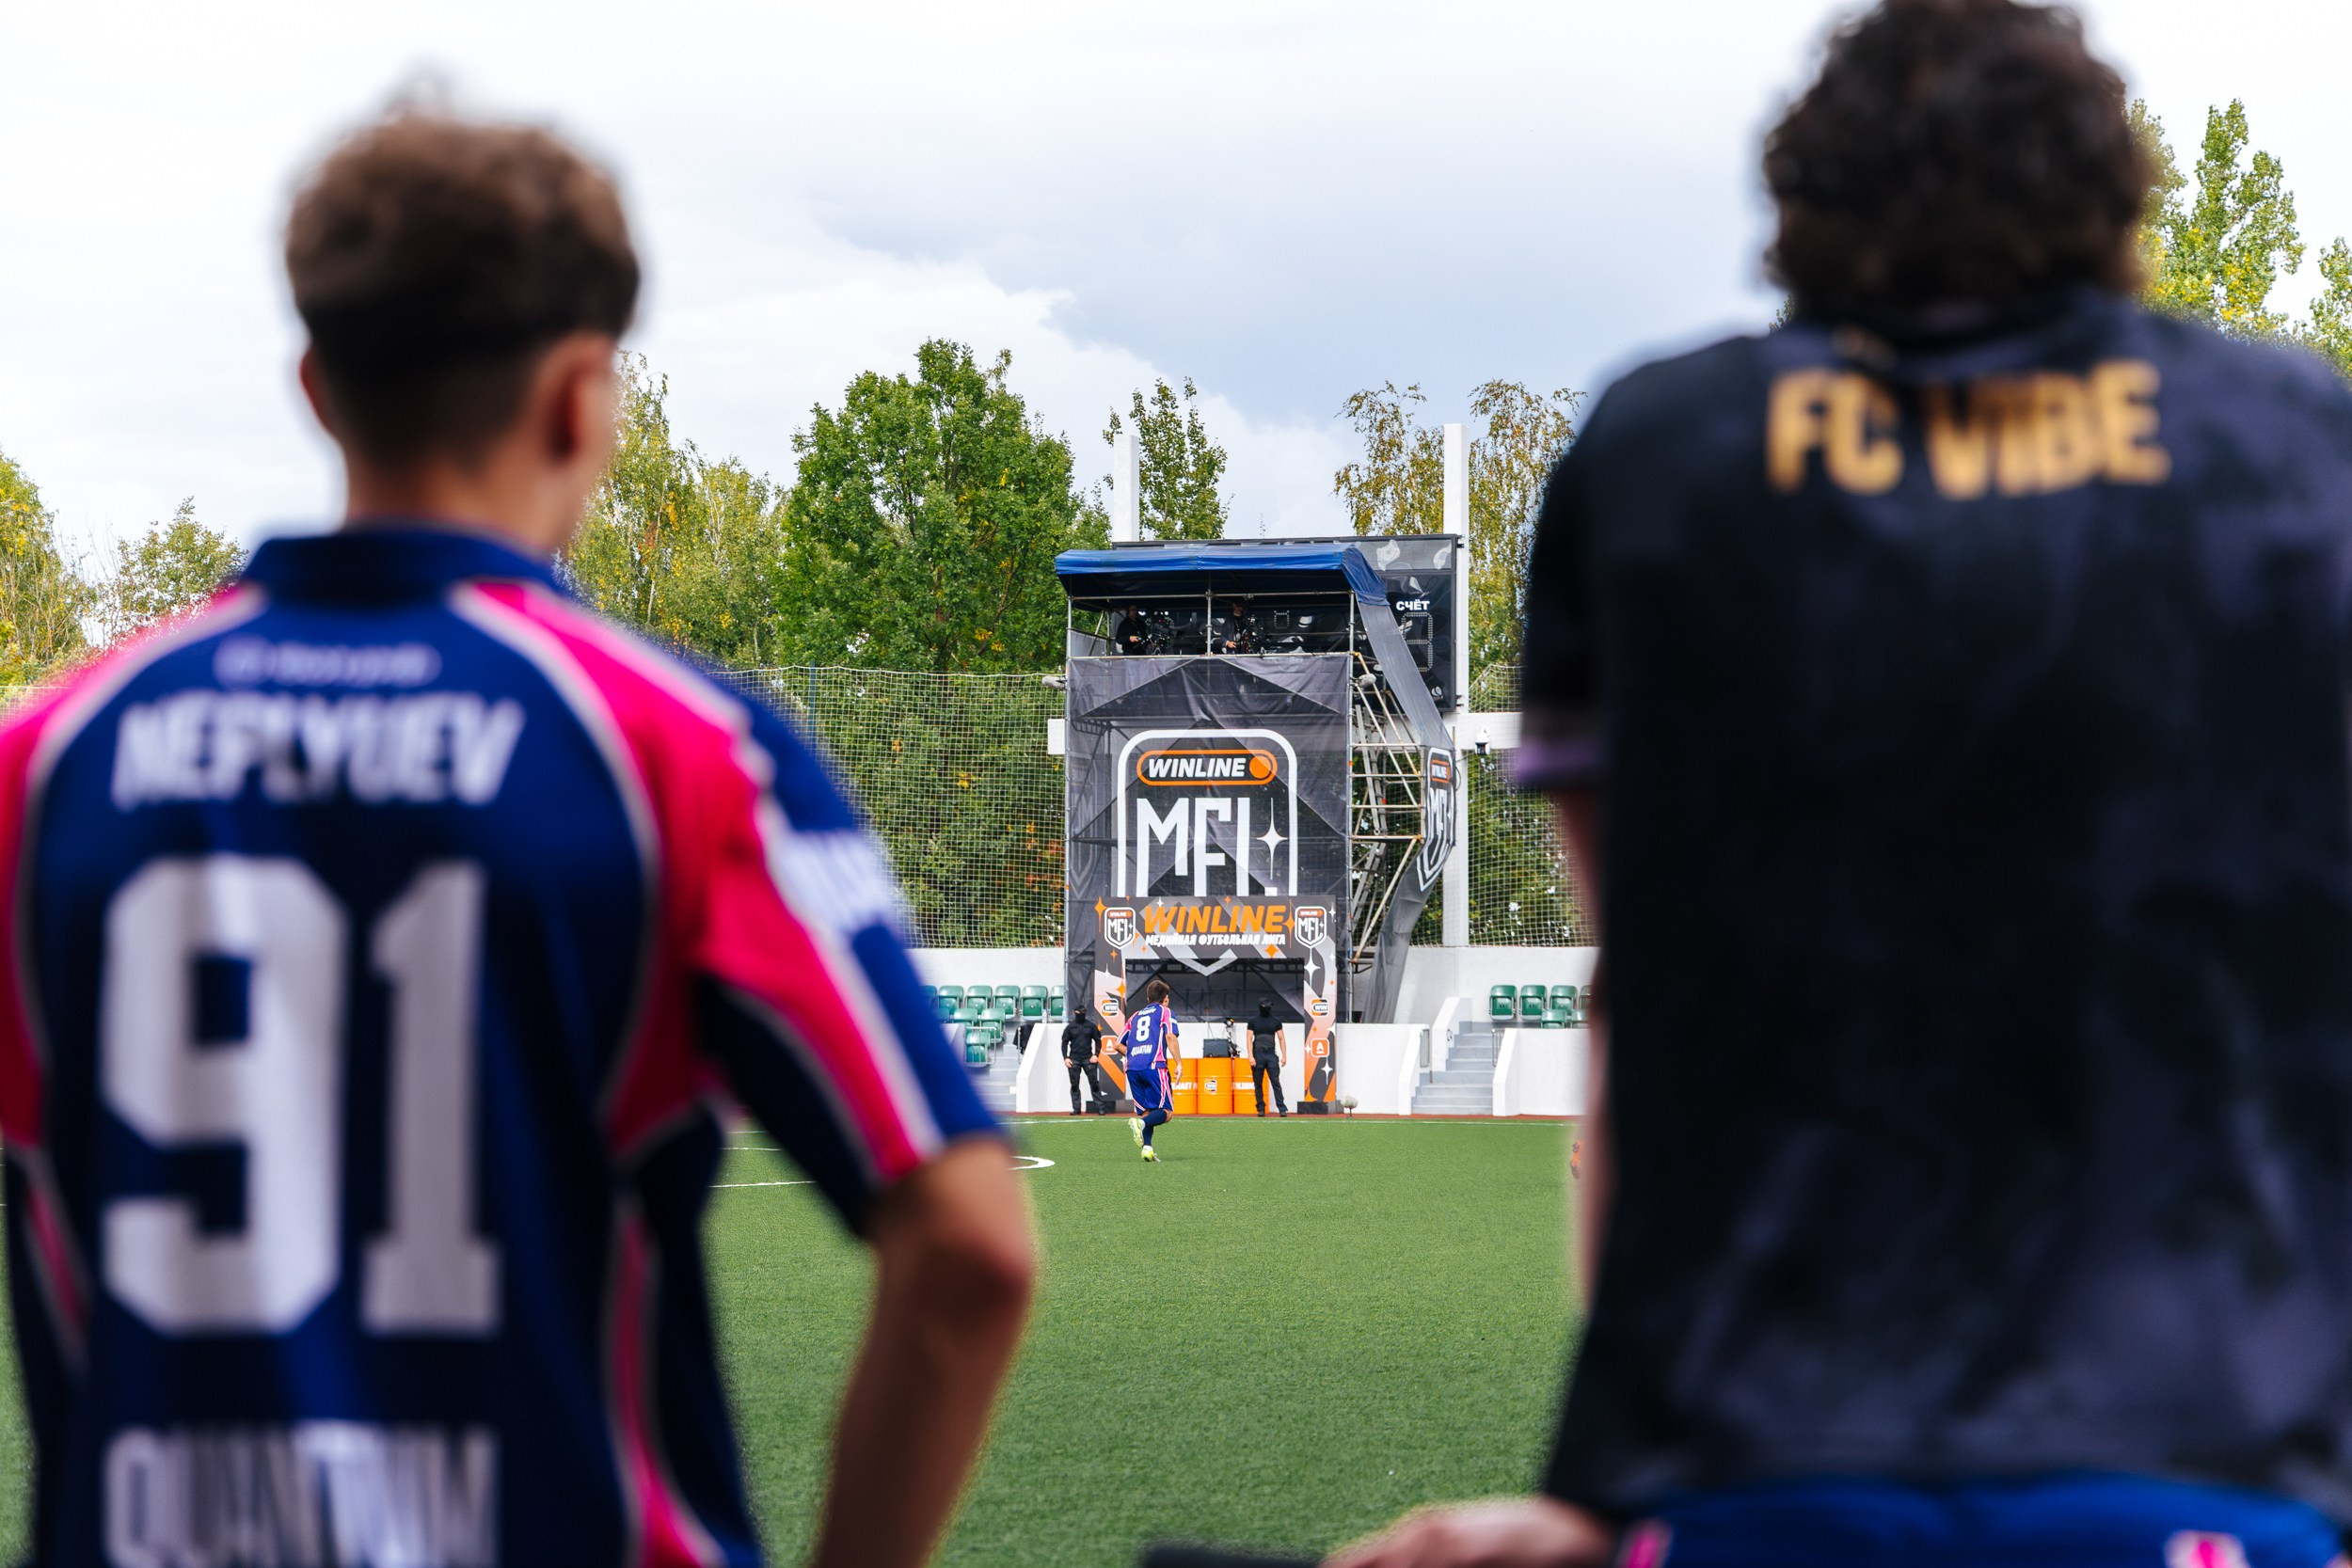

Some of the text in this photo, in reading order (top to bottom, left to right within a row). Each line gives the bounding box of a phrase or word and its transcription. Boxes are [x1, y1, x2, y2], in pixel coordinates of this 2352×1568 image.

[1765, 359, 2171, 500] FC VIBE
[1396, 599, 1430, 611] СЧЁТ
[1148, 757, 1247, 779] WINLINE
[1107, 918, 1133, 945] MFL
[1144, 905, 1286, 933] WINLINE
[1298, 917, 1323, 944] MFL
[1198, 934, 1261, 945] ФУТБОЛЬНАЯ
[1136, 1015, 1152, 1042] 8
[103, 852, 501, 1335] 91
